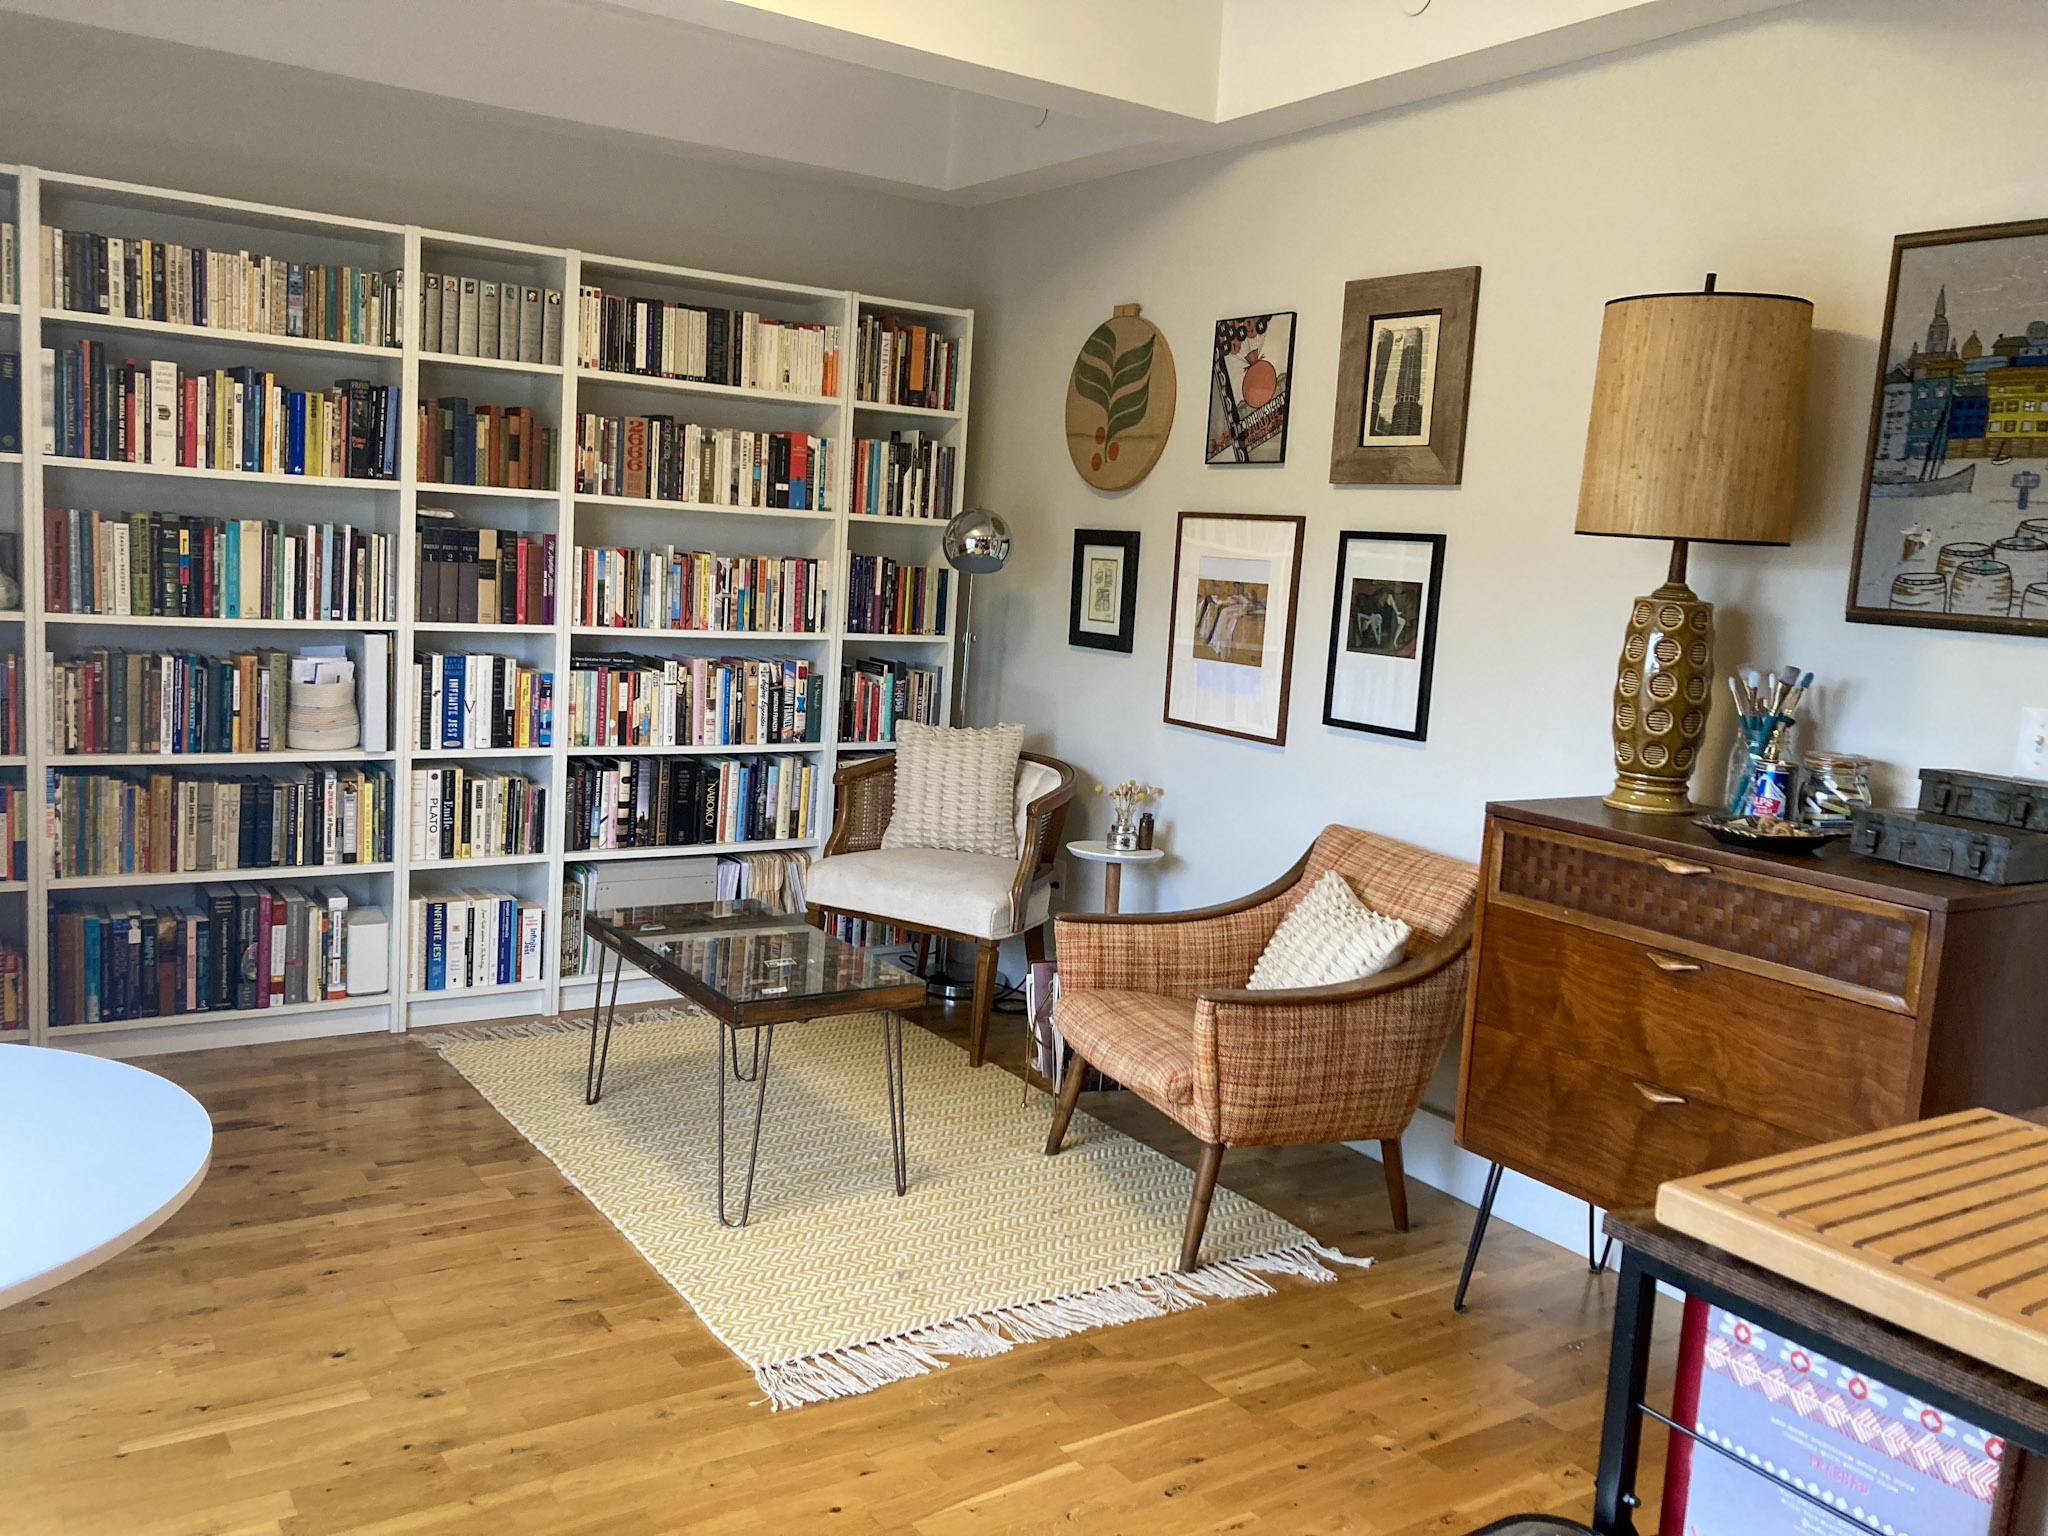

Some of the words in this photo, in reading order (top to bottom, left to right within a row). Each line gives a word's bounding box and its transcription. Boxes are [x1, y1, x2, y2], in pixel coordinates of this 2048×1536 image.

[119, 420, 125, 428] OF
[627, 420, 644, 472] 2666
[663, 419, 672, 459] SOLENOID
[447, 553, 453, 562] 2
[467, 554, 473, 562] 3
[447, 679, 459, 715] INFINITE
[760, 679, 769, 700] Jeffrey
[758, 700, 769, 727] Eugenides
[783, 706, 794, 730] FRANZEN
[447, 718, 458, 737] JEST
[429, 798, 438, 833] PLATO
[443, 801, 454, 830] Emile
[705, 784, 715, 827] NABOKOV
[433, 904, 443, 940] INFINITE
[144, 935, 154, 966] MMPI-2
[432, 943, 442, 962] JEST
[523, 941, 531, 955] Jest
[529, 928, 537, 952] Infinite
